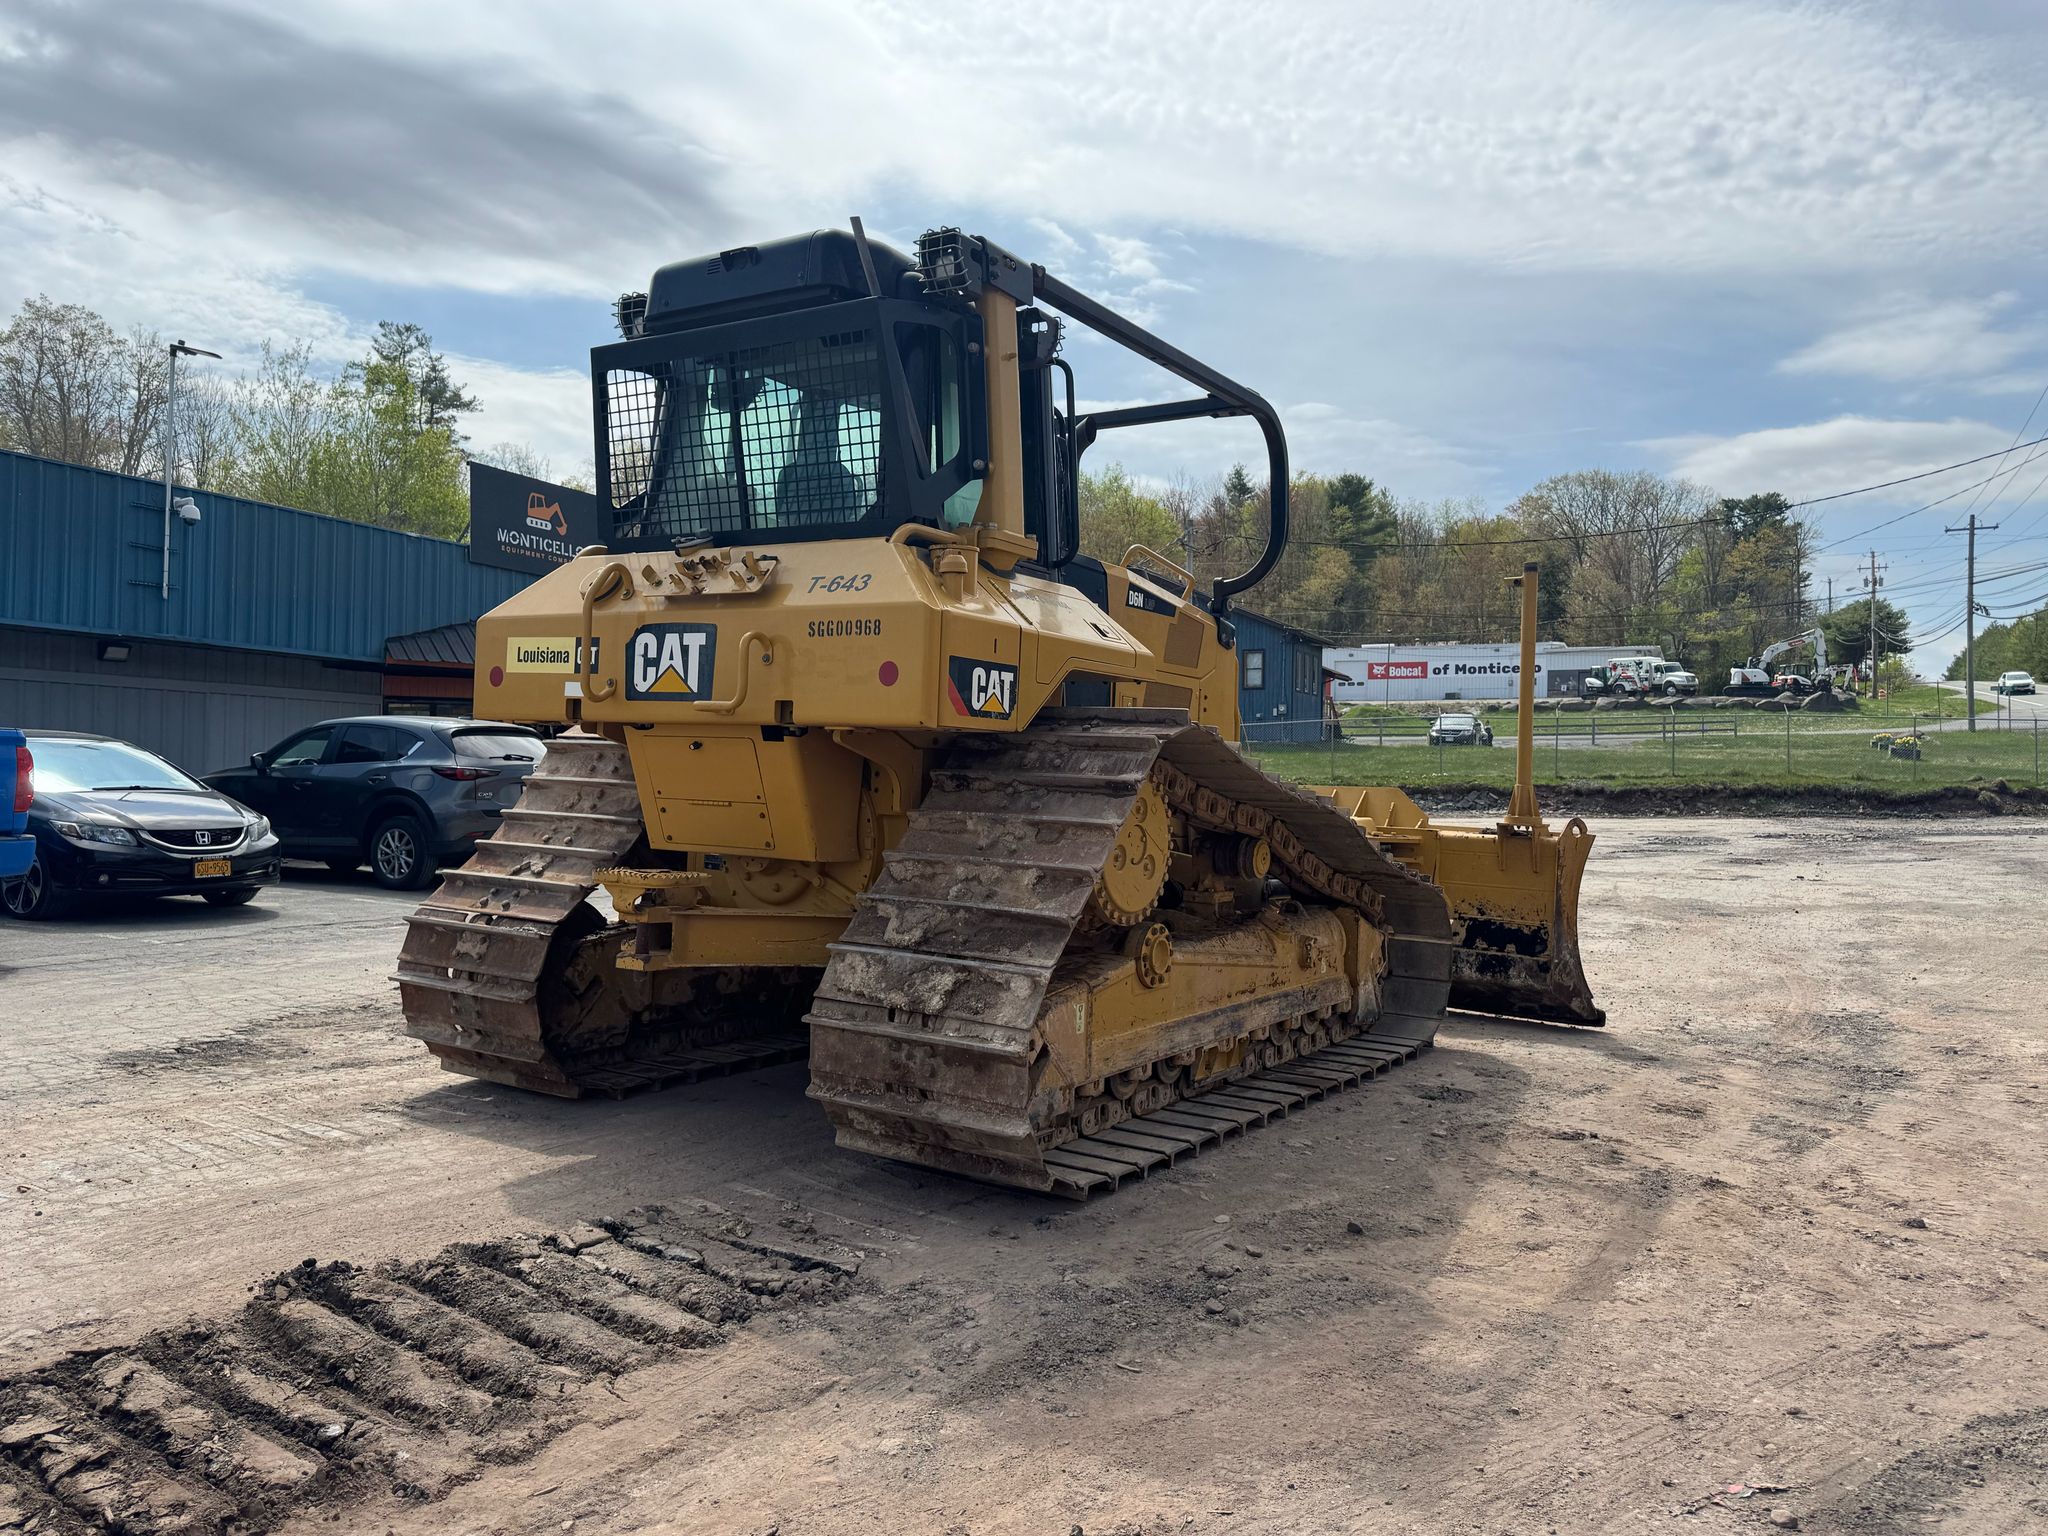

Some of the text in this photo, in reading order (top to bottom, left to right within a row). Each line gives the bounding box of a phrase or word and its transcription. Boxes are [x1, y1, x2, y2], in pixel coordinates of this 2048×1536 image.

[501, 545, 545, 559] EQUIPMENT
[807, 574, 872, 593] T-643
[1128, 590, 1144, 608] D6N
[808, 619, 881, 637] SGG00968
[517, 646, 599, 665] Louisiana CT
[633, 632, 706, 693] CAT
[1389, 663, 1542, 677] Bobcat of Monticeo
[971, 666, 1014, 714] CAT
